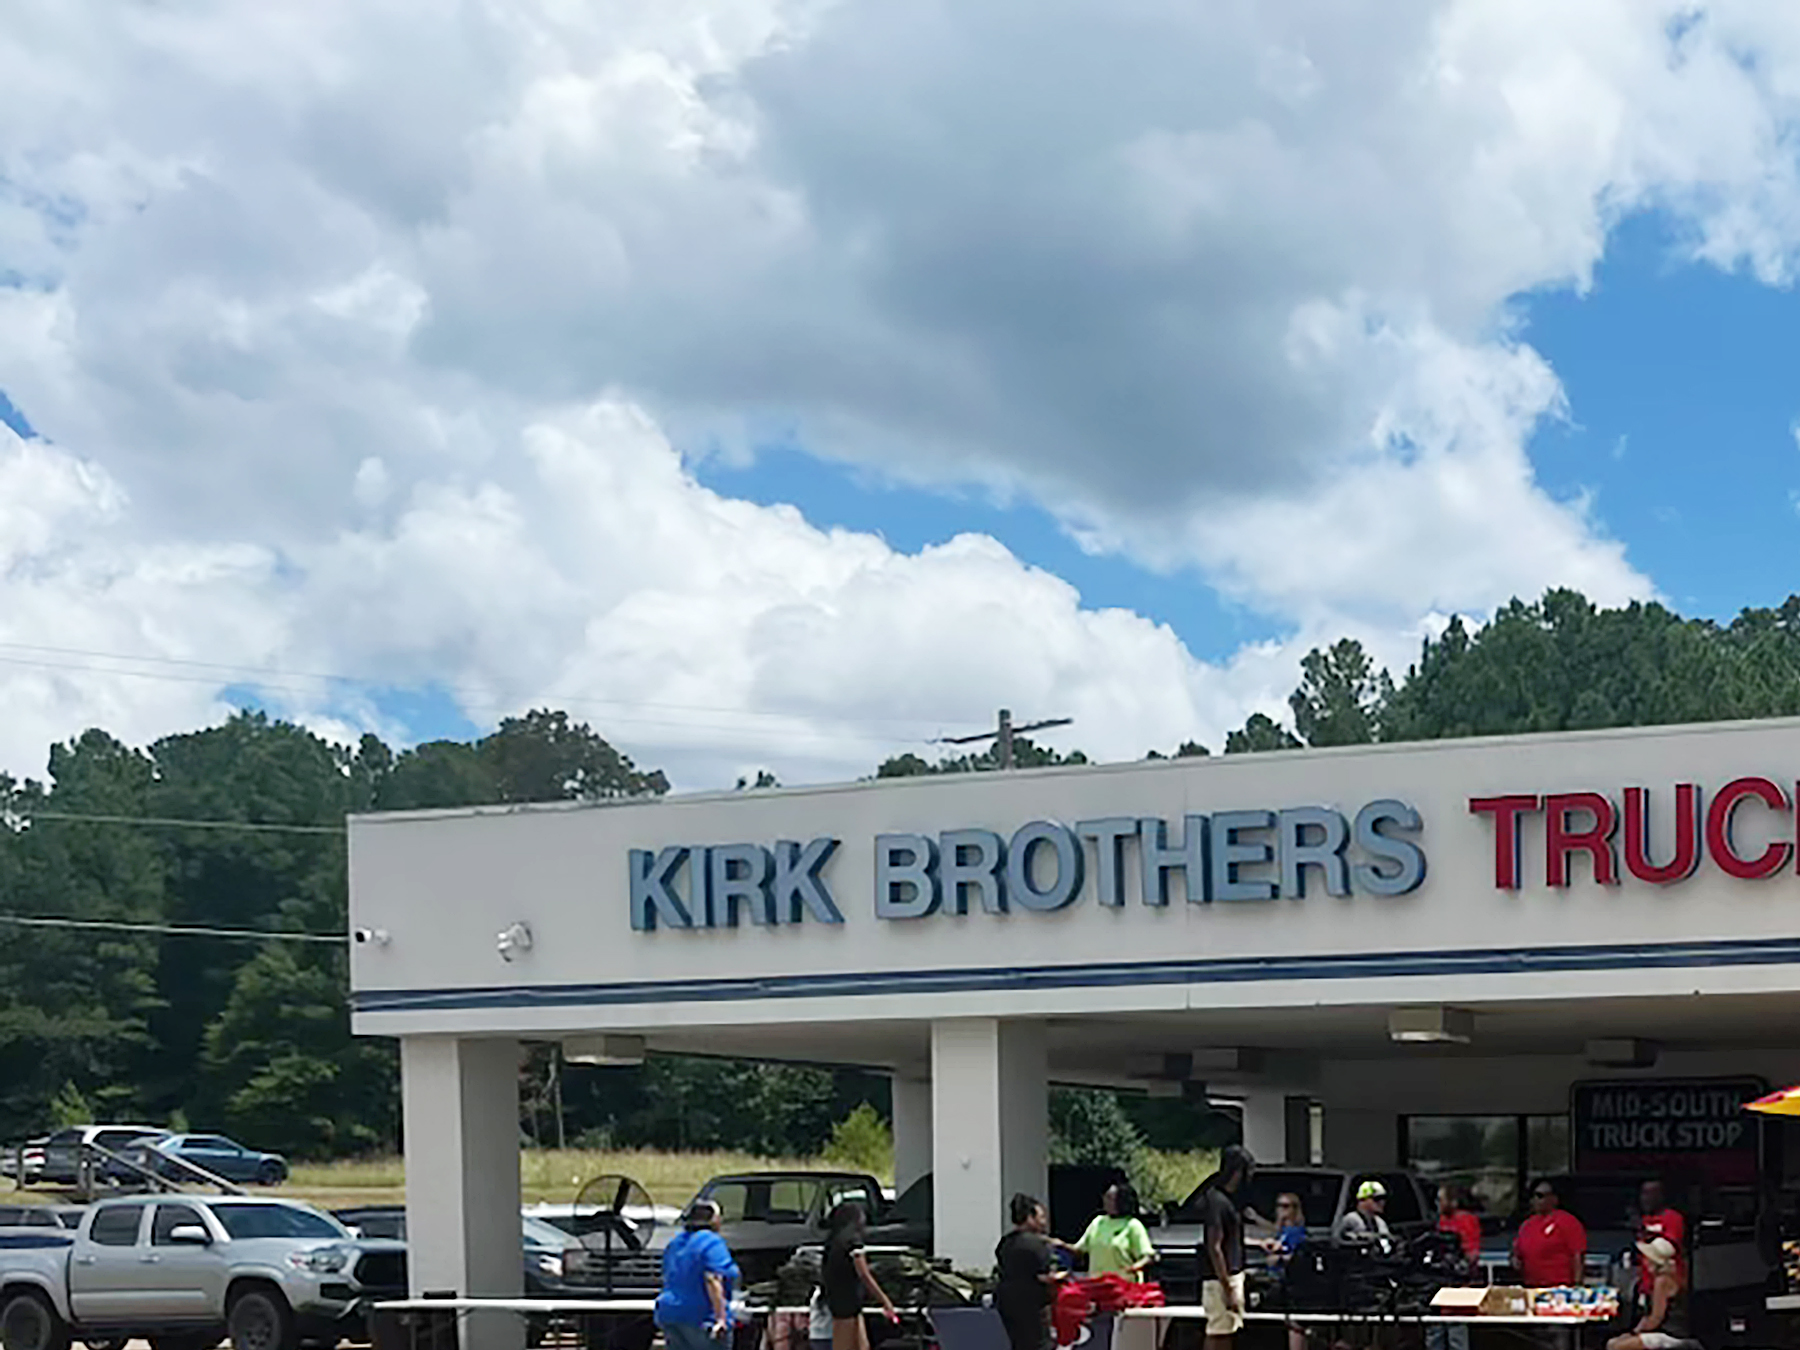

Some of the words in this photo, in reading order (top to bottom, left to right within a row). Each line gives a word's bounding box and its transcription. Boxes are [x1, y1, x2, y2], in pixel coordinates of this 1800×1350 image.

[627, 837, 846, 932] KIRK
[871, 800, 1426, 922] BROTHERS
[1592, 1091, 1742, 1118] MID-SOUTH
[1589, 1121, 1672, 1149] TRUCK
[1675, 1120, 1743, 1148] STOP
